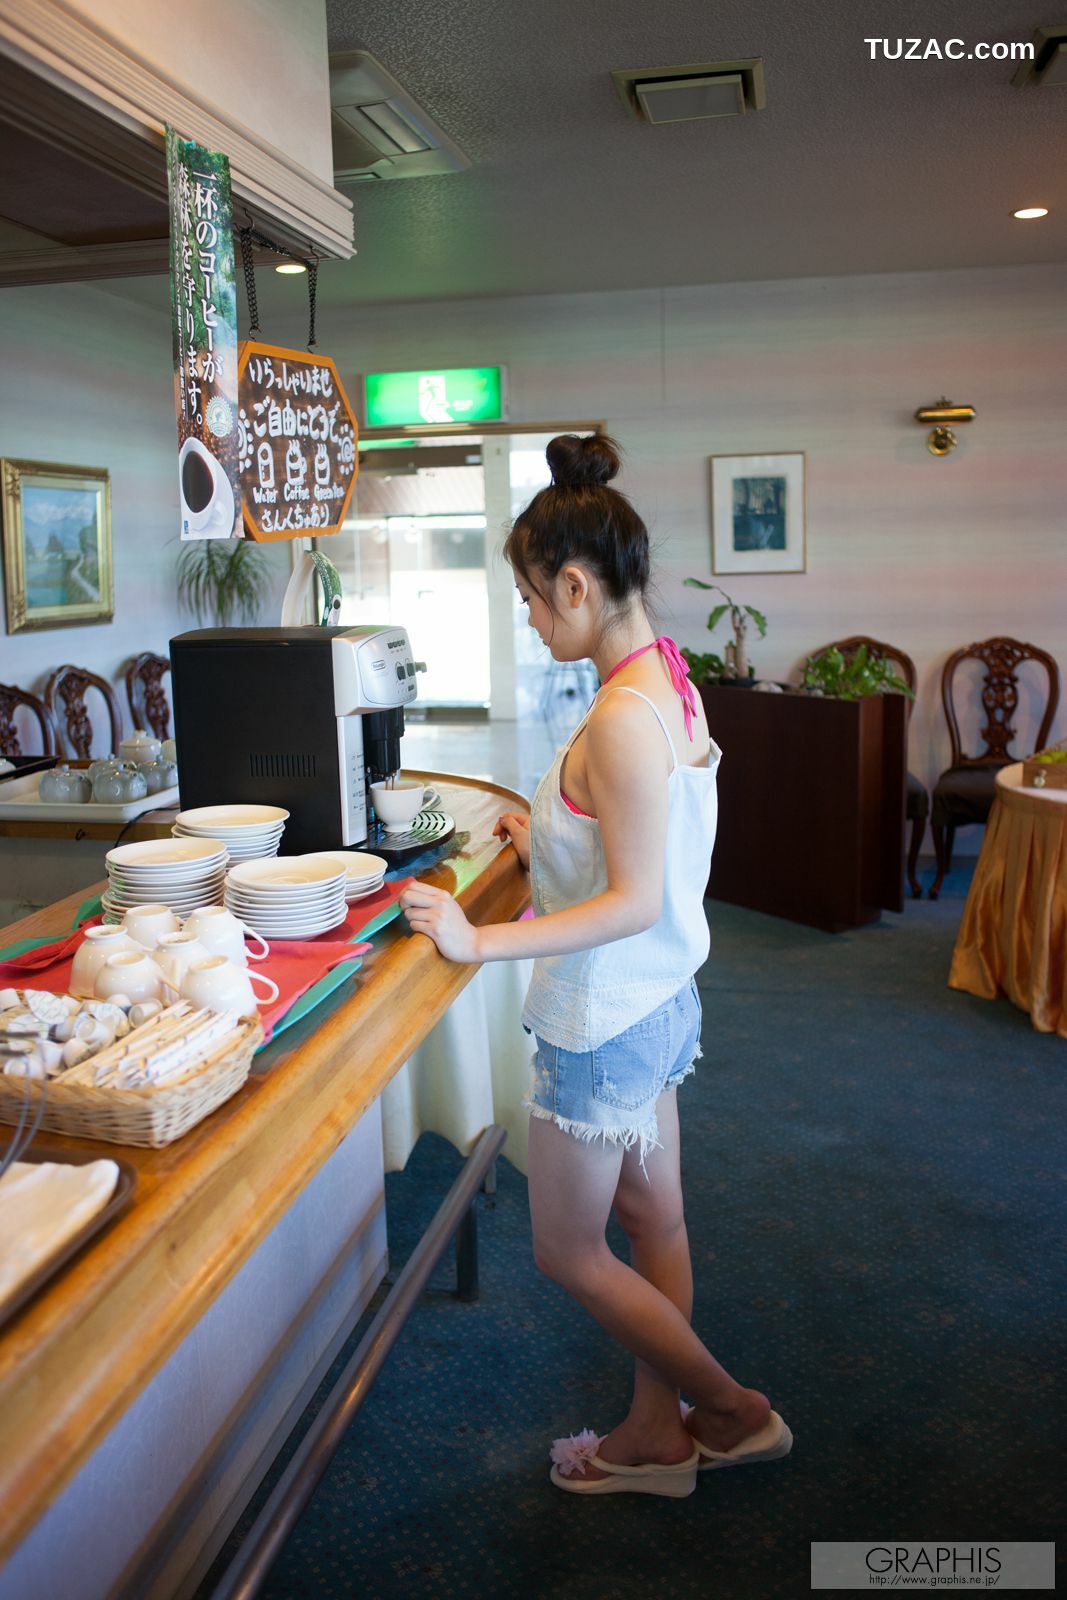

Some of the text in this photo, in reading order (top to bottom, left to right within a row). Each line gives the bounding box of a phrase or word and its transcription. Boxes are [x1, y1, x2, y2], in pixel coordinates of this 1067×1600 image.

[177, 161, 203, 426] 森林を守ります。
[192, 170, 223, 384] 一杯のコーヒーが
[248, 357, 333, 398] いらっしゃいませ
[252, 395, 341, 444] ご自由にどうぞ
[252, 486, 278, 504] Water
[284, 482, 310, 502] Coffee
